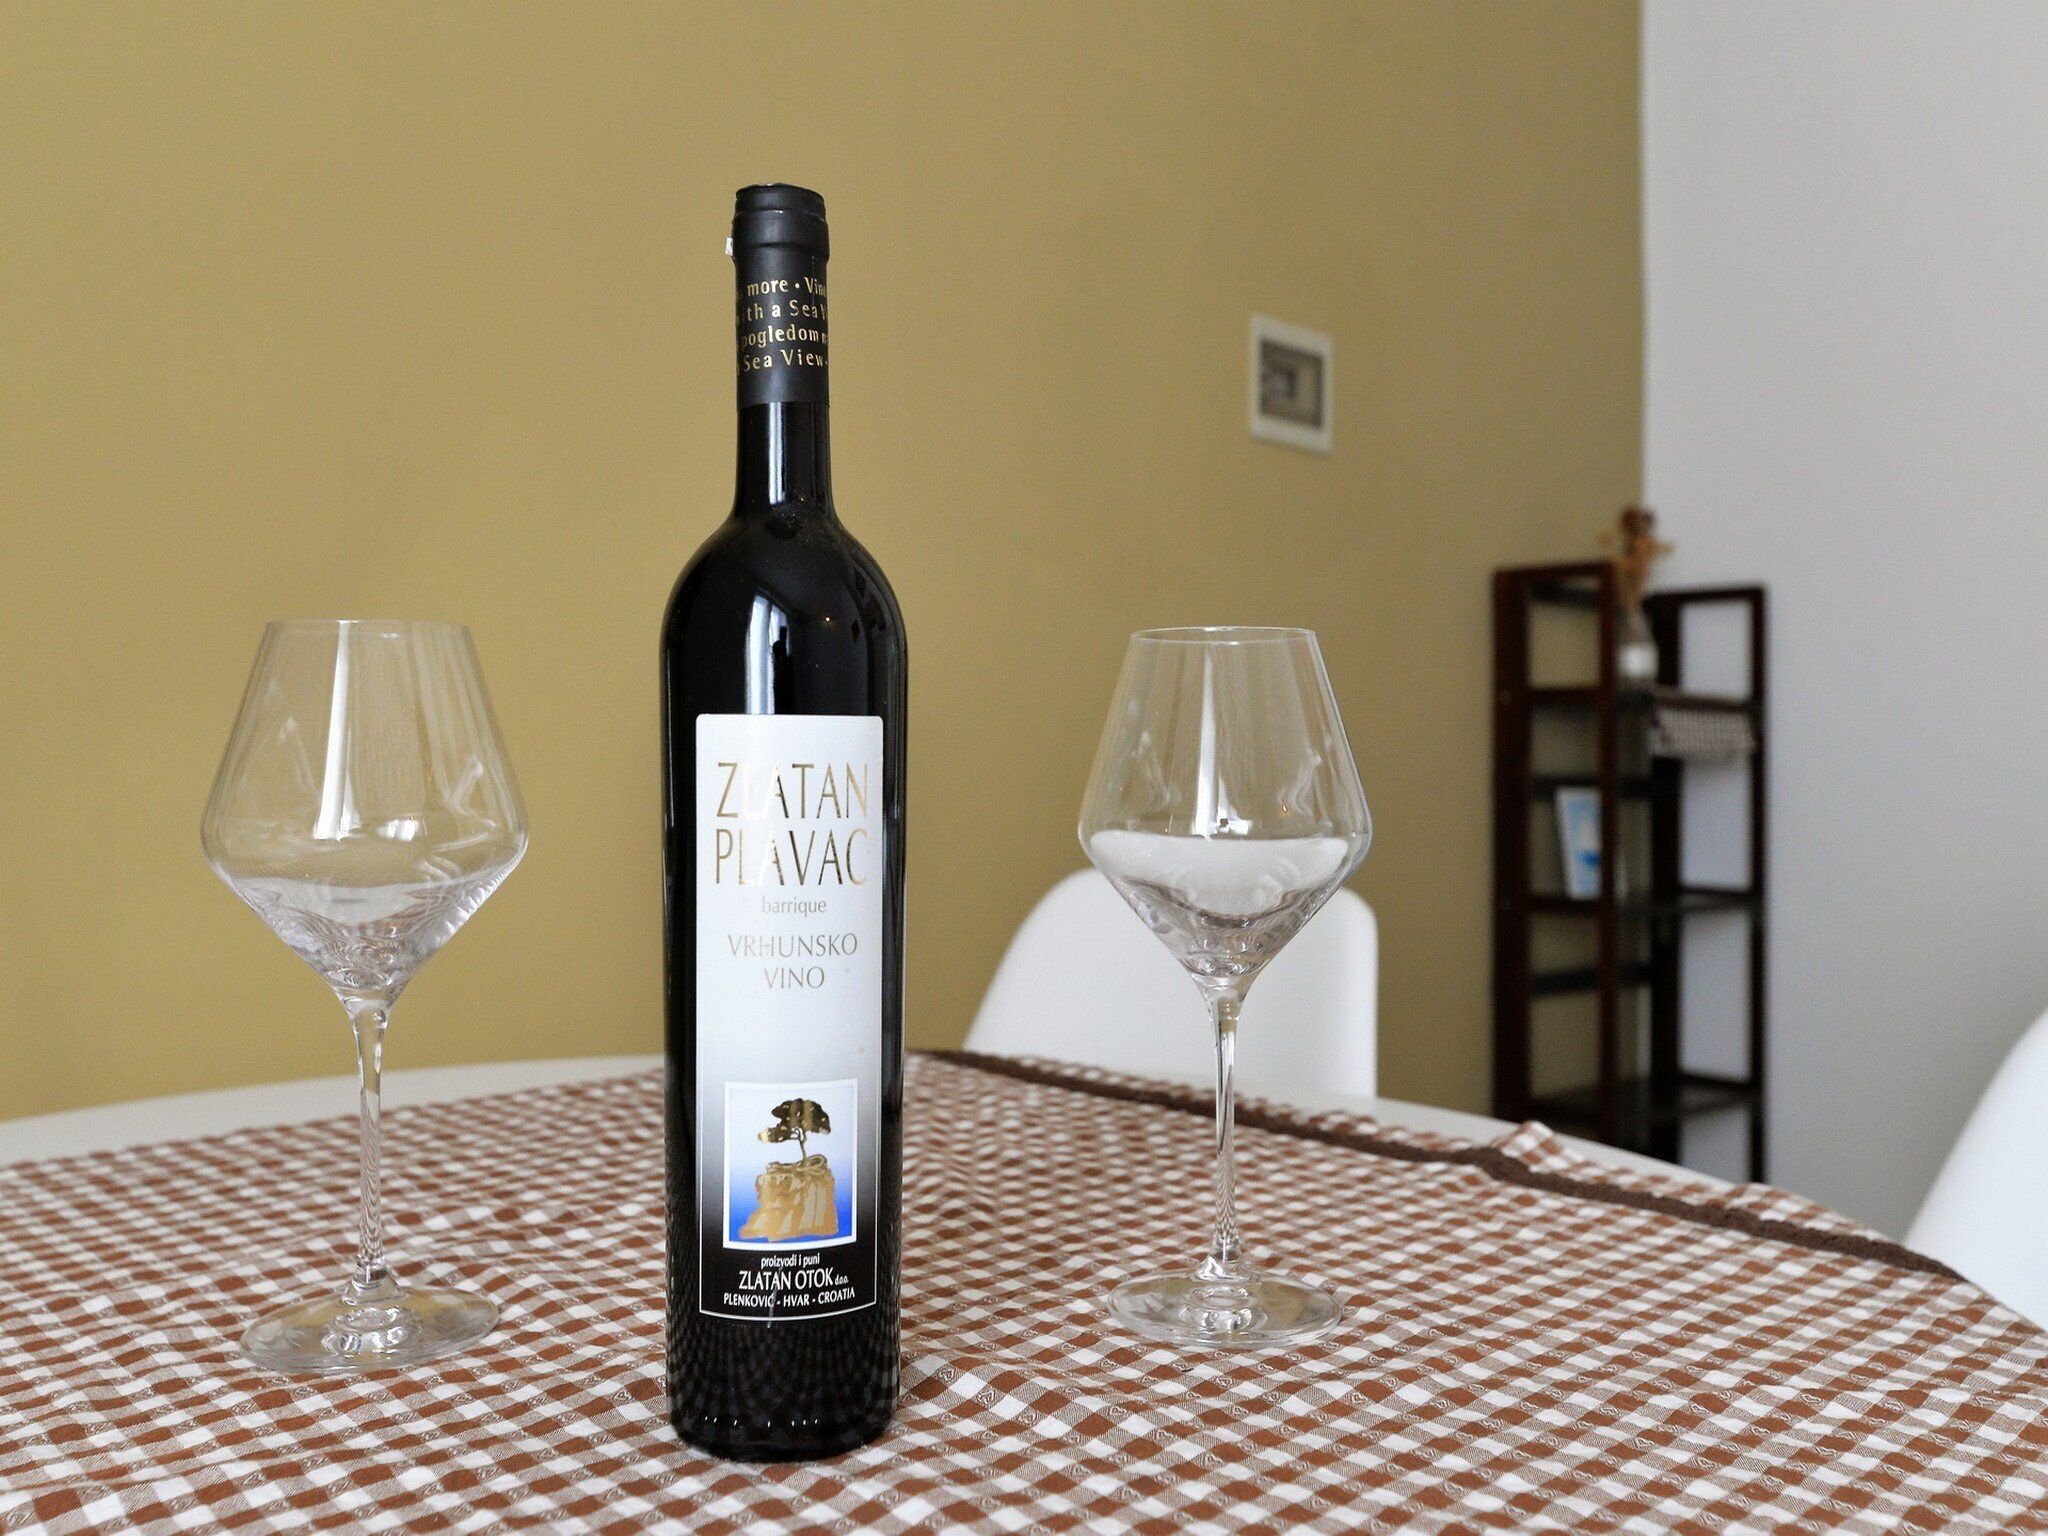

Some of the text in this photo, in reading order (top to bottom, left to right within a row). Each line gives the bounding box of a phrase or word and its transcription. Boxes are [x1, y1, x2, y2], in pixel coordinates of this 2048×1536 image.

[747, 279, 789, 297] more
[771, 304, 781, 319] a
[789, 299, 818, 319] Sea
[741, 324, 819, 350] pogledom
[743, 354, 773, 372] Sea
[716, 761, 868, 820] ZLATAN
[715, 827, 868, 886] PLAVAC
[761, 895, 827, 917] barrique
[728, 932, 858, 958] VRHUNSKO
[763, 966, 826, 989] VINO
[803, 1252, 820, 1268] puni
[738, 1270, 792, 1290] ZLATAN
[794, 1267, 834, 1290] OTOK
[783, 1293, 810, 1308] HVAR
[817, 1286, 856, 1305] CROATIA
